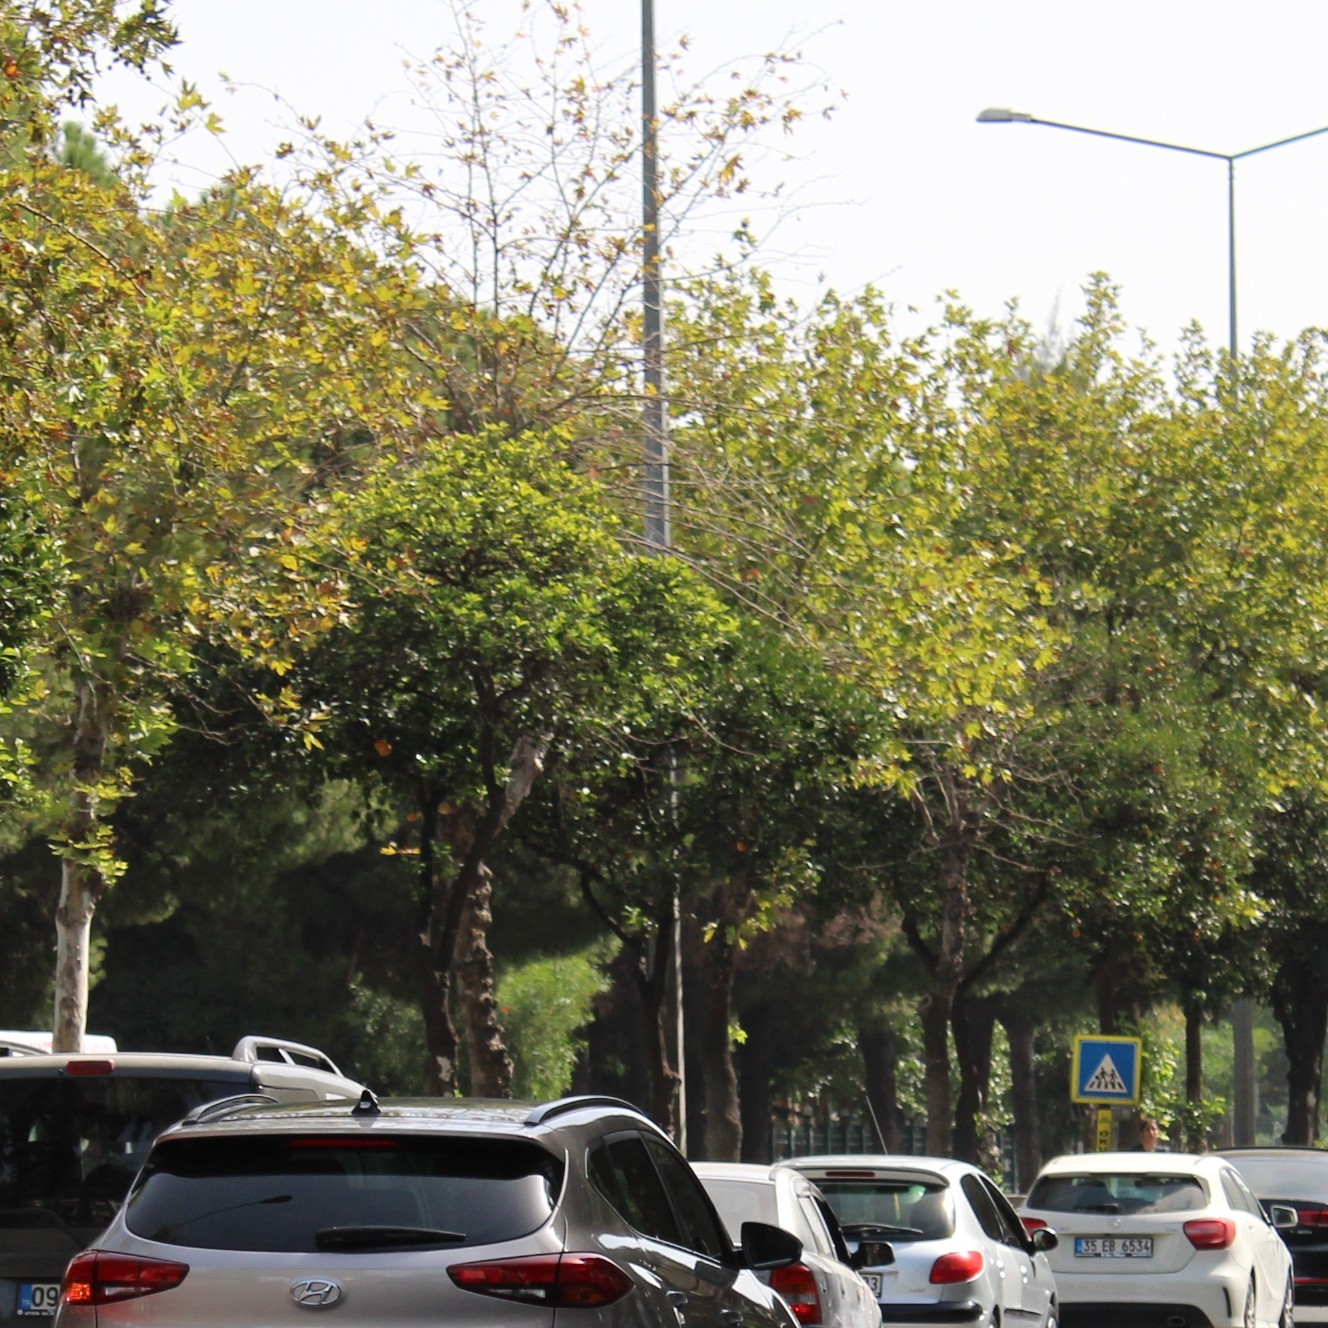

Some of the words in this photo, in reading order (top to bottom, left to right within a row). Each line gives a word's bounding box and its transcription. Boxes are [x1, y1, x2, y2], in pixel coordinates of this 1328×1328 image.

[1083, 1240, 1098, 1252] 35
[1122, 1240, 1150, 1252] 6534
[32, 1286, 59, 1307] 09
